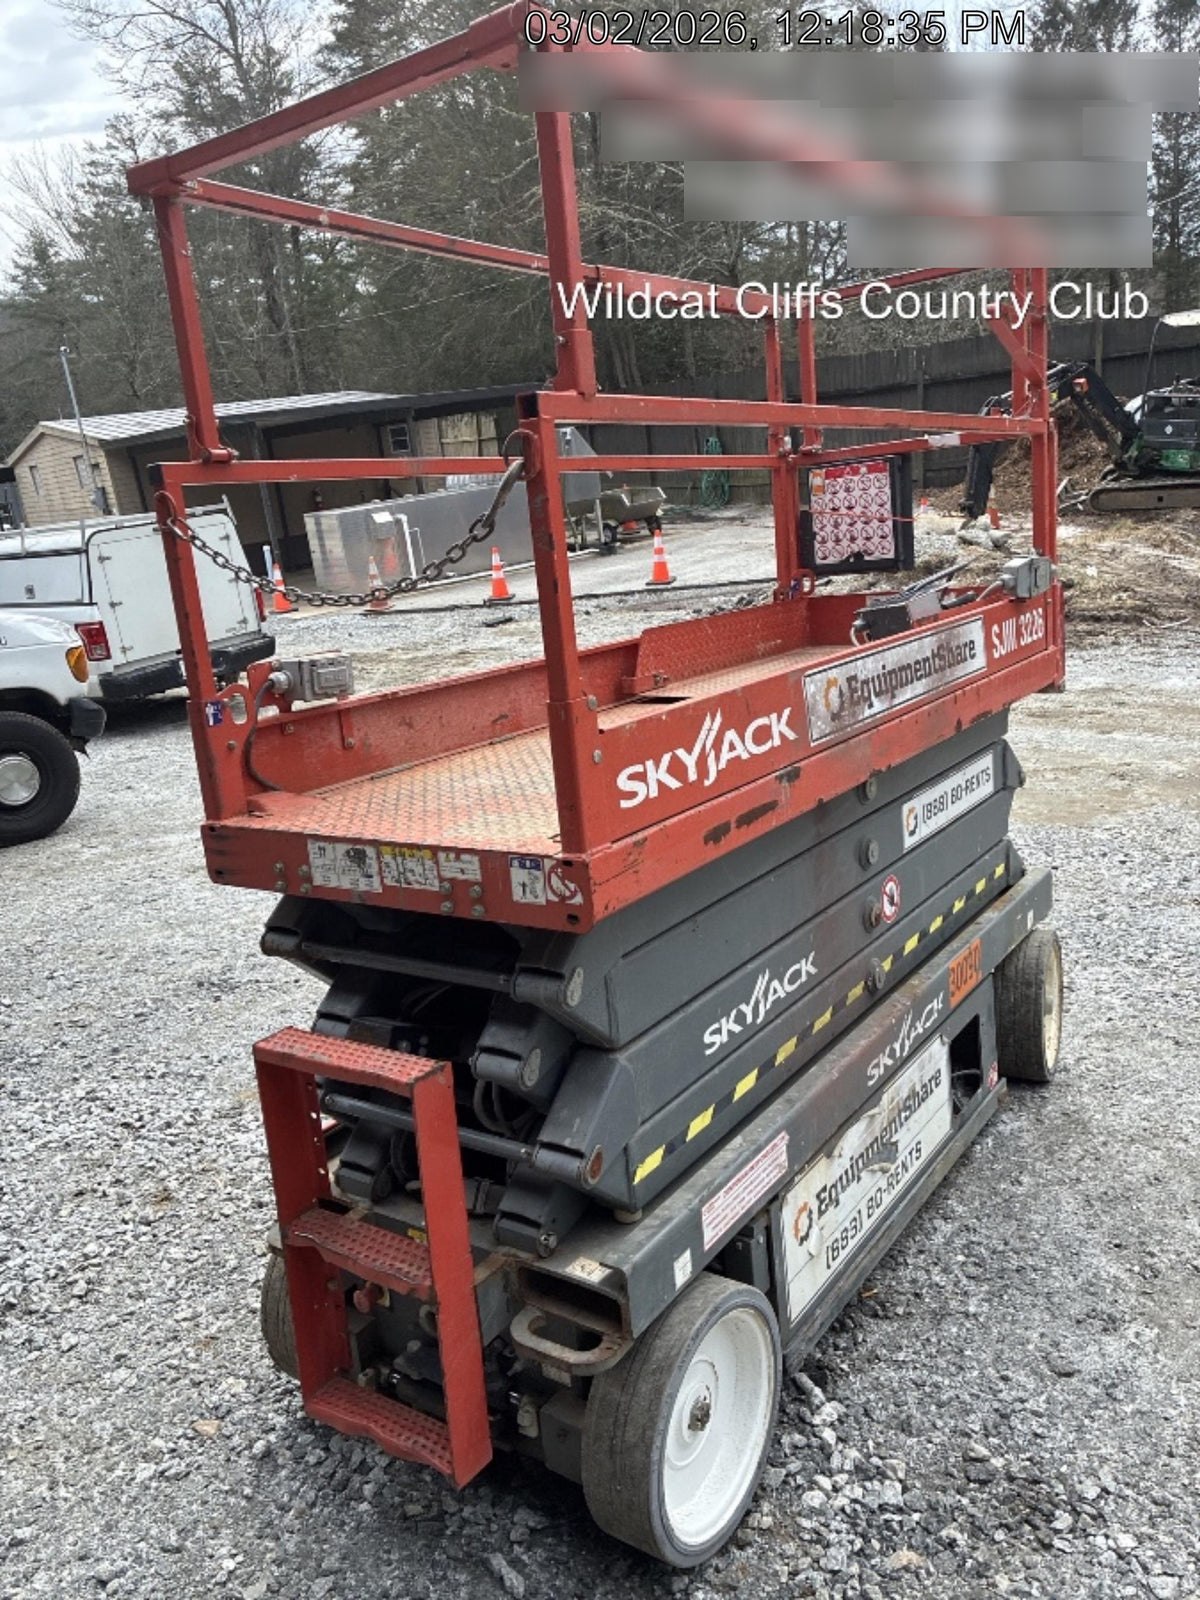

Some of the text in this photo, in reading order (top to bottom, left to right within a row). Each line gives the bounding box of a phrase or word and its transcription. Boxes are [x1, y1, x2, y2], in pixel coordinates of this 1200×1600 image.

[845, 638, 978, 710] EquipmentShare
[616, 708, 798, 808] SKYJACK
[703, 951, 819, 1057] SKYJACK
[815, 1066, 943, 1222] EquipmentShare
